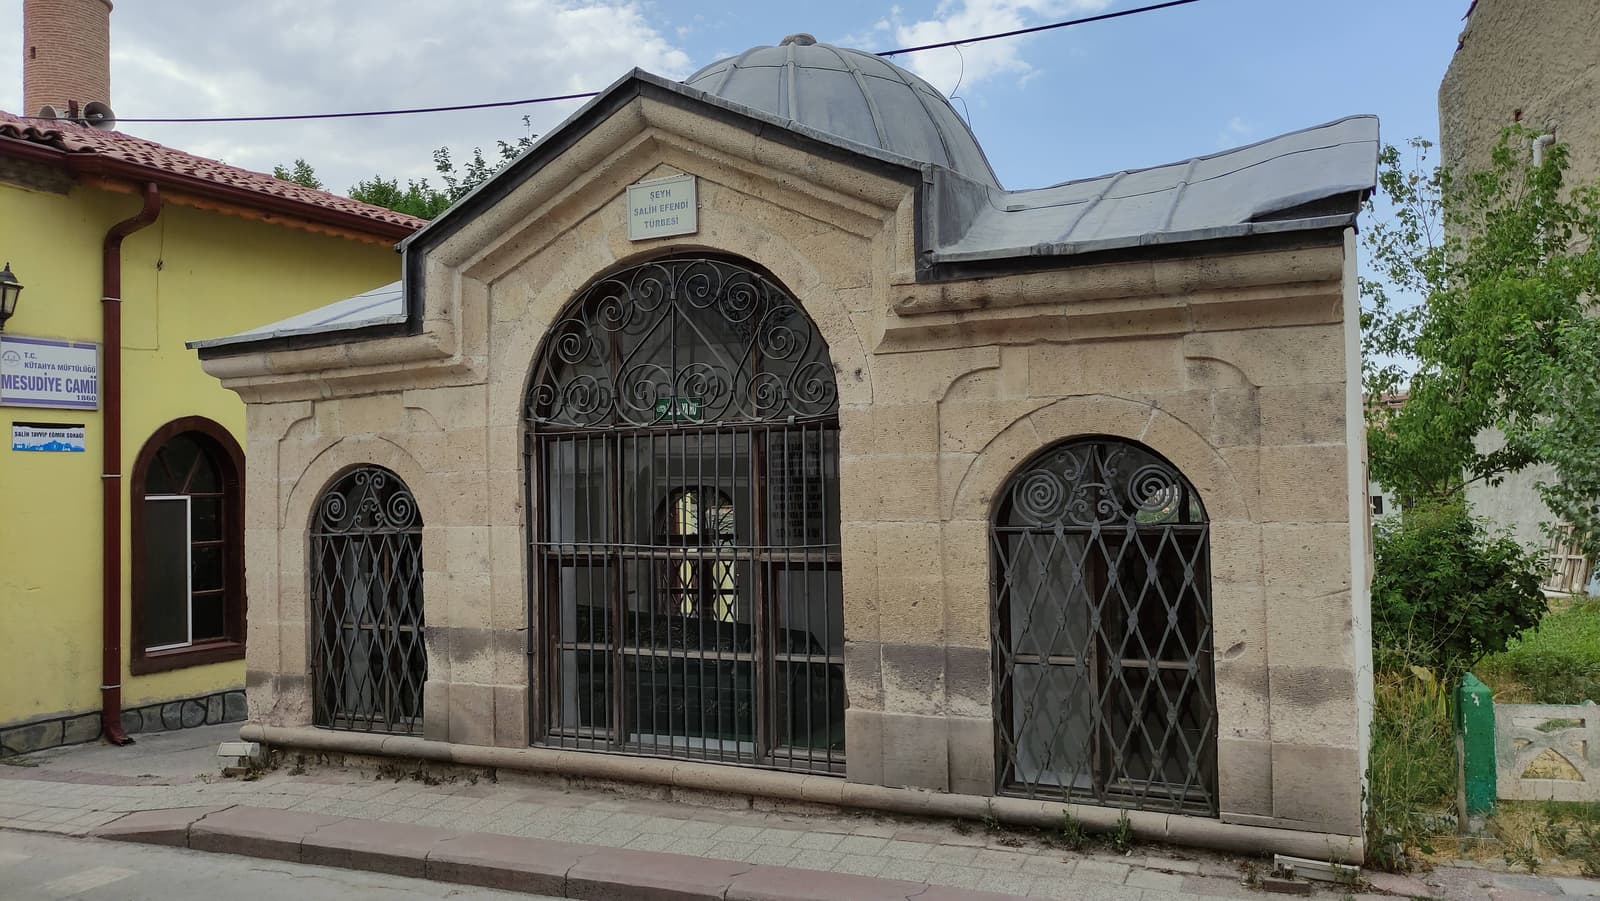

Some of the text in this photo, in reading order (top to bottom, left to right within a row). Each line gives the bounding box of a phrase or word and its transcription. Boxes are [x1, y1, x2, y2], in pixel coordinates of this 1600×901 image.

[650, 189, 671, 201] ŞEYH
[633, 201, 688, 216] SALİH EFENDİ
[644, 216, 678, 229] TÜRBESİ
[24, 352, 37, 360] T.C.
[24, 361, 96, 373] KÜTAHYA MÜFTÜLÜĞÜ
[1, 372, 96, 394] MESUDİYE CAMİİ
